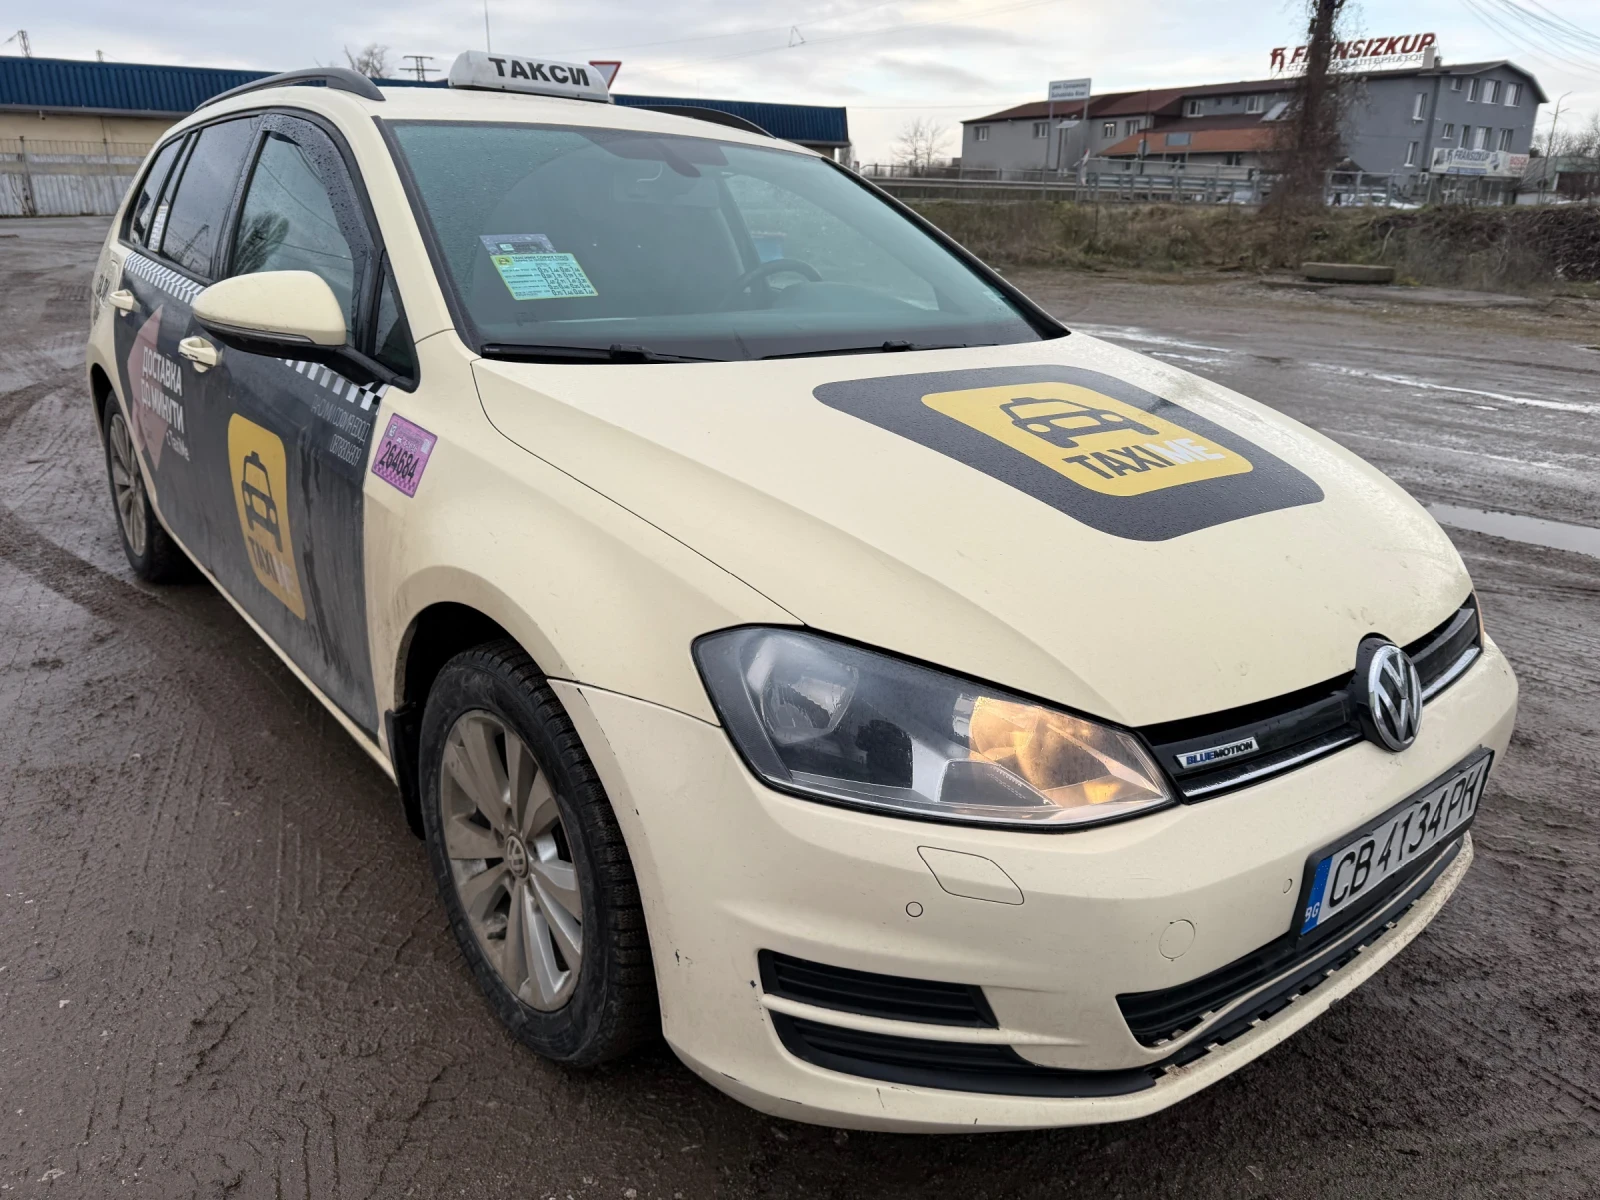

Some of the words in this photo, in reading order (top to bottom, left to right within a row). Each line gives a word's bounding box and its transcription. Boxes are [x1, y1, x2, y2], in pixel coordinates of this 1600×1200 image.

[488, 57, 590, 87] ТАКСИ
[142, 346, 182, 396] ДОСТАВКА
[141, 378, 152, 410] ДО
[151, 385, 185, 434] МИНУТИ
[379, 440, 420, 482] 264684
[1185, 740, 1253, 766] BLUEMOTION
[1329, 839, 1375, 908] CB
[1377, 789, 1448, 874] 4134
[1443, 764, 1484, 830] PH
[1304, 901, 1320, 922] BG
